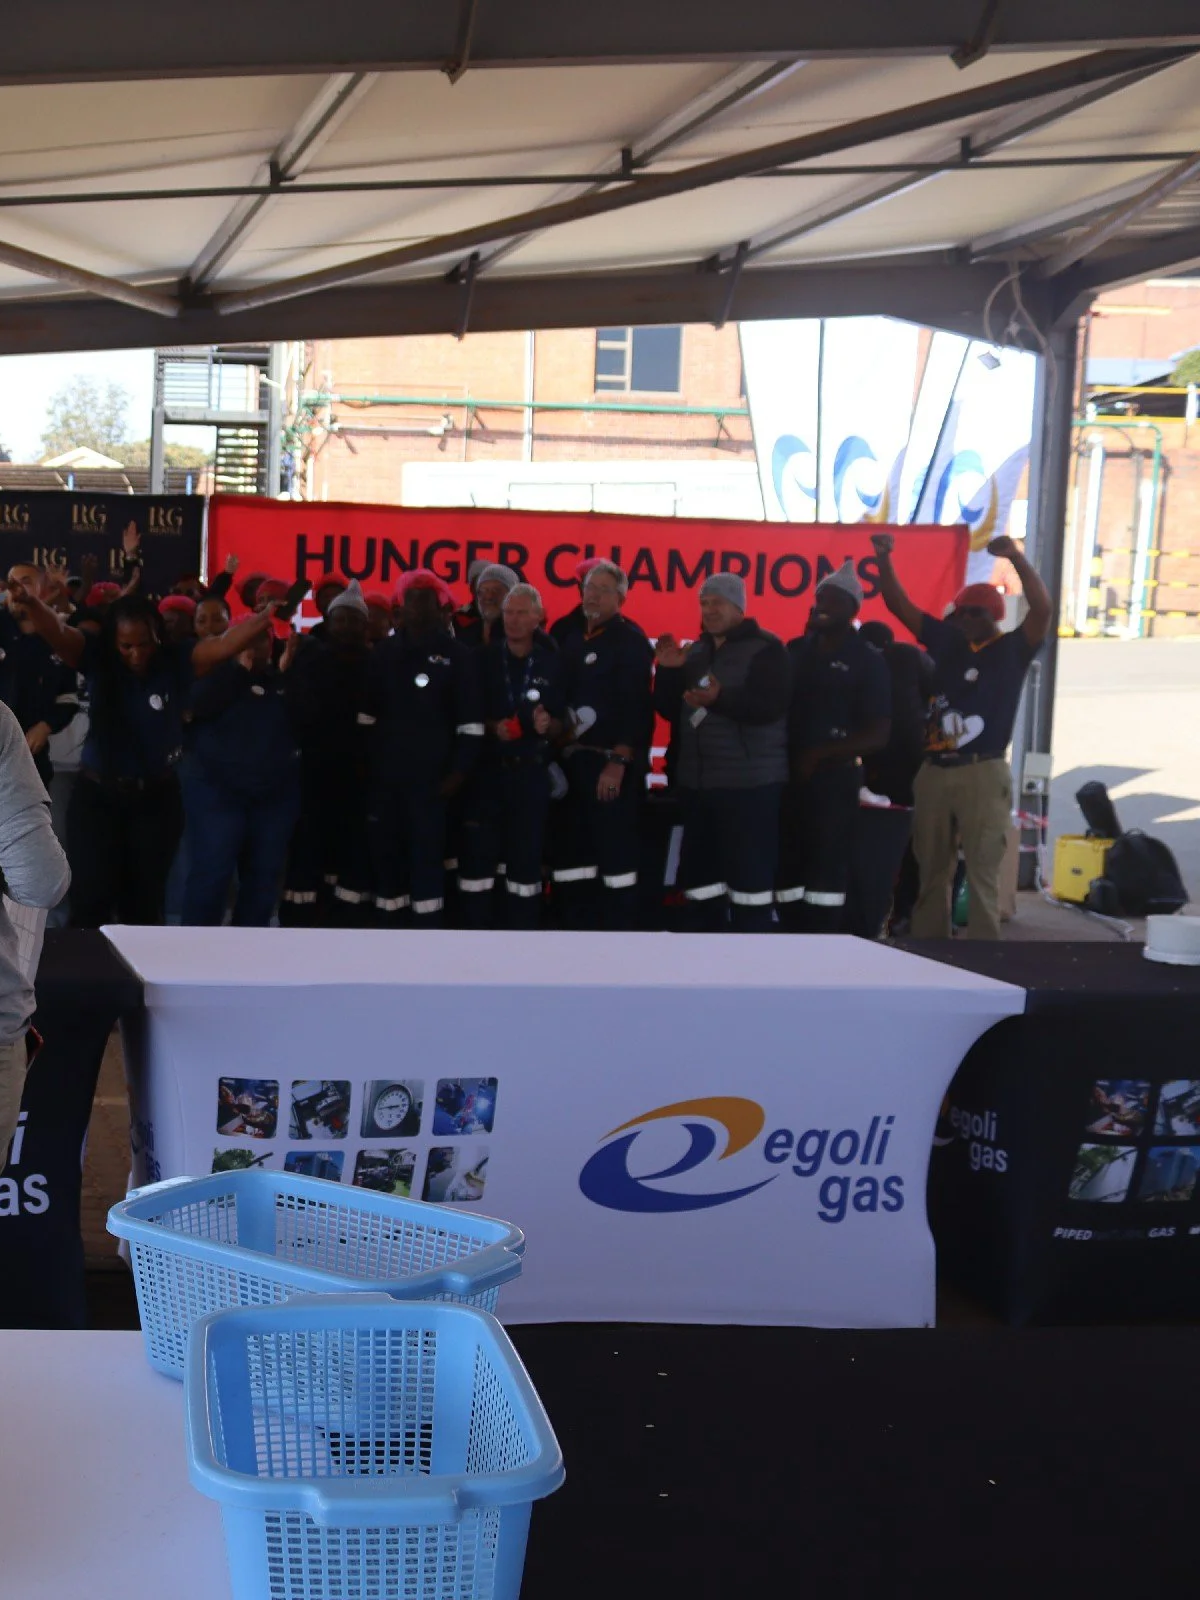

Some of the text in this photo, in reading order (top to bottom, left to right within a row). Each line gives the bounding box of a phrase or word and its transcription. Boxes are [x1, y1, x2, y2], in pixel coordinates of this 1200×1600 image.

[950, 1105, 998, 1142] egoli
[764, 1116, 896, 1177] egoli
[969, 1140, 1009, 1173] gas
[817, 1174, 905, 1223] gas
[1148, 1227, 1176, 1238] GAS
